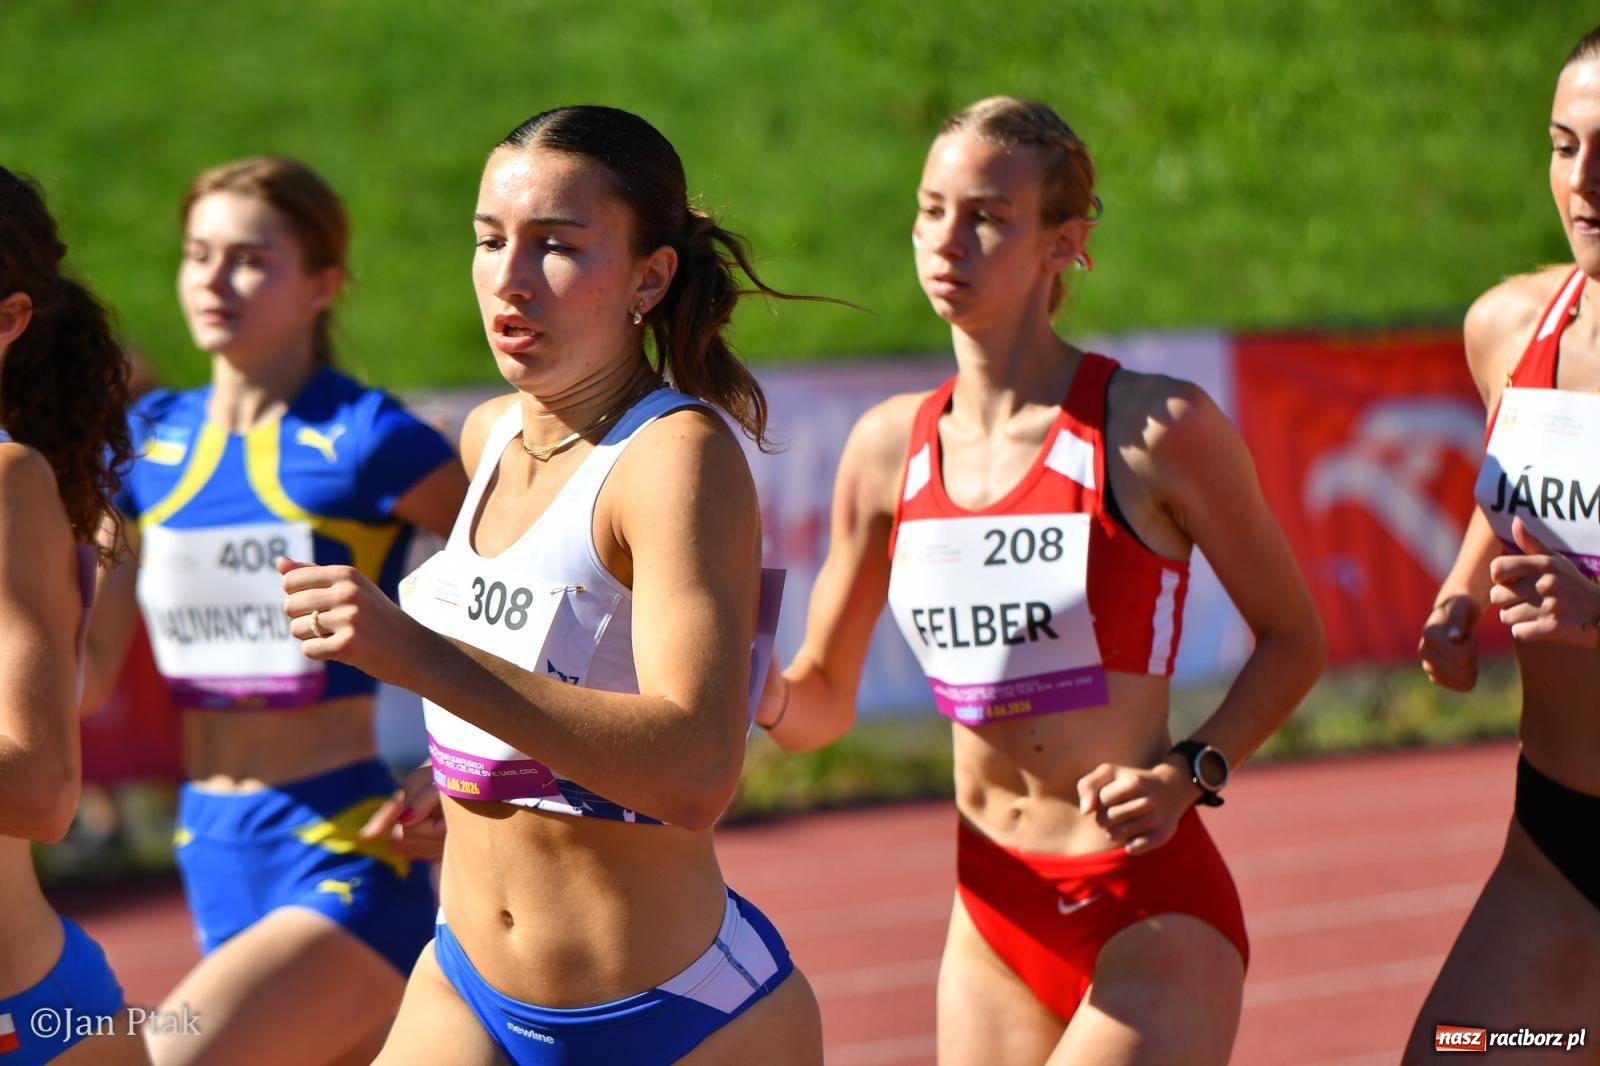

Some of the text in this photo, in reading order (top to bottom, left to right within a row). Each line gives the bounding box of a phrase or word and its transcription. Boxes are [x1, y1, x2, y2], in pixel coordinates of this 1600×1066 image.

[218, 536, 289, 573] 408
[983, 526, 1064, 567] 208
[468, 576, 534, 631] 308
[911, 601, 1060, 649] FELBER
